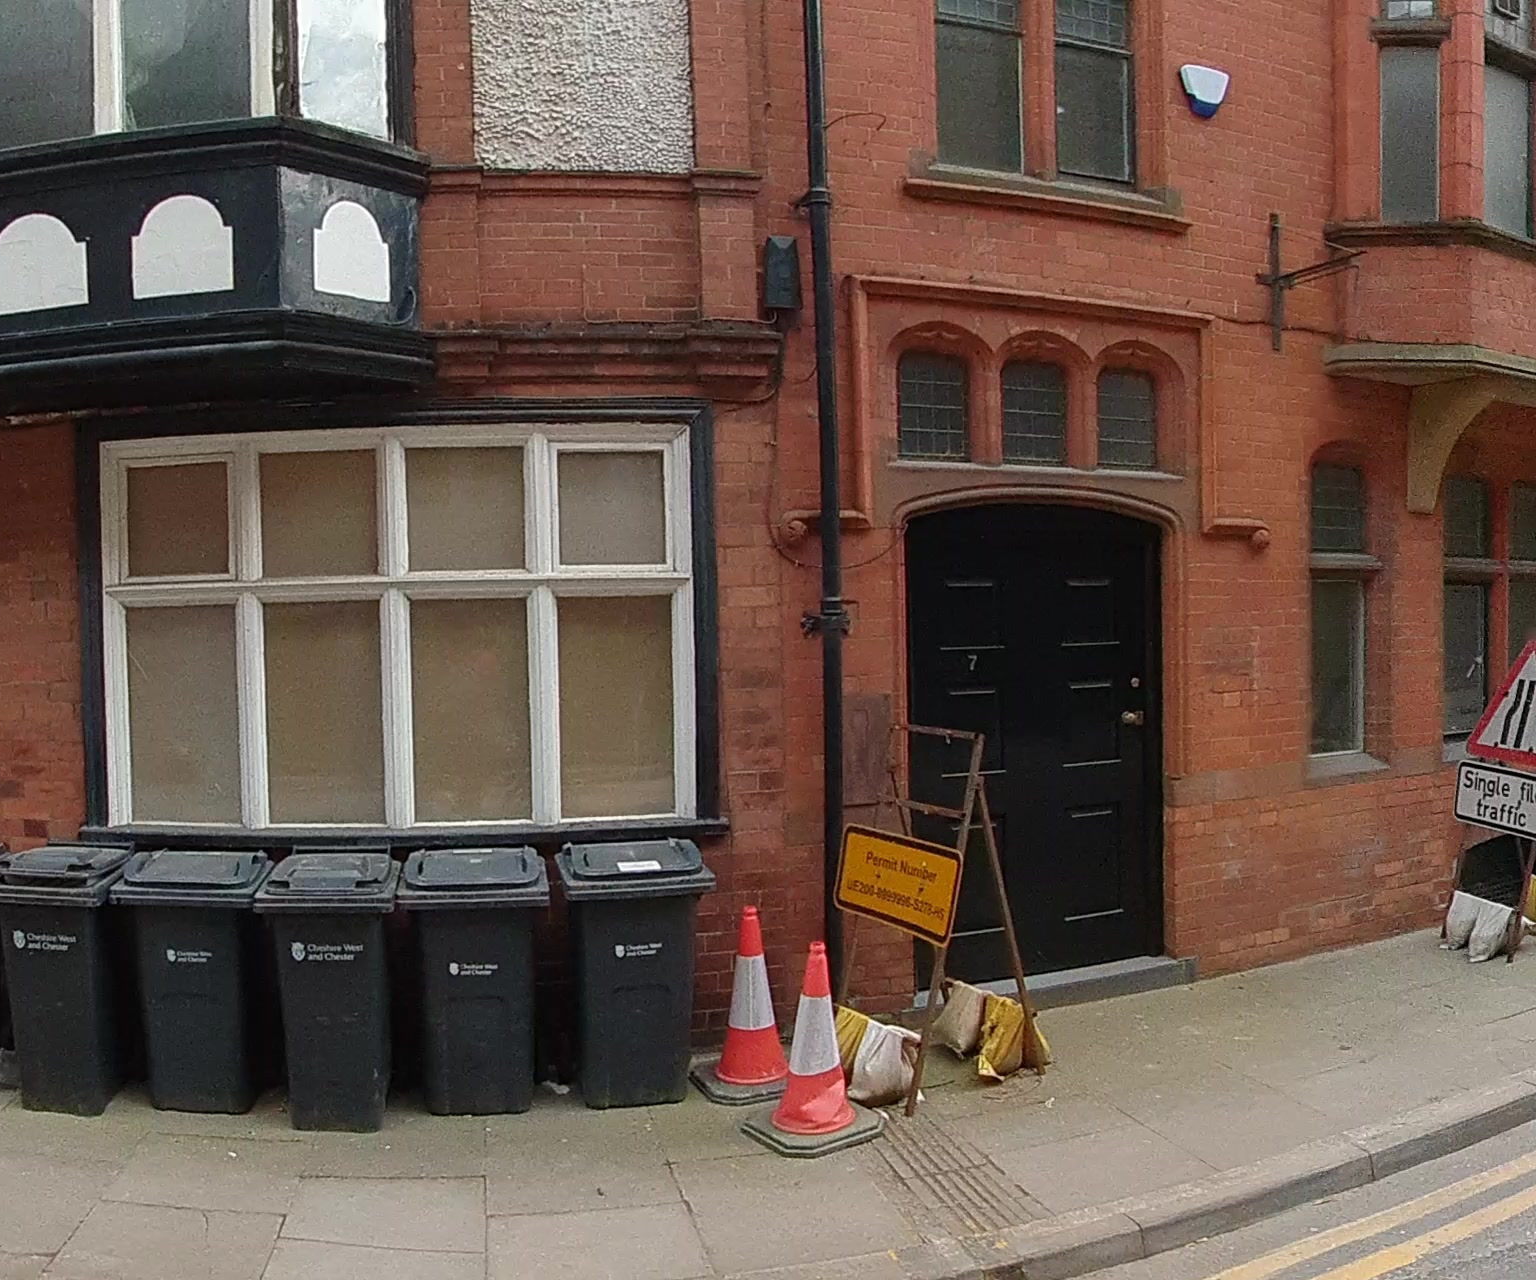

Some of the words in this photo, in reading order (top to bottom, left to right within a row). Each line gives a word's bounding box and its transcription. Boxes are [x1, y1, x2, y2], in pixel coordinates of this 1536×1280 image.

[1463, 770, 1510, 797] Single
[1477, 798, 1527, 827] traffic
[866, 851, 898, 872] Permit
[900, 860, 937, 882] Number
[27, 933, 57, 943] Cheshire
[58, 934, 76, 943] West
[27, 942, 41, 950] and
[42, 942, 68, 951] Chester
[307, 943, 342, 952] Cheshire
[343, 944, 364, 952] West
[307, 953, 323, 961] and
[324, 952, 355, 961] Chester
